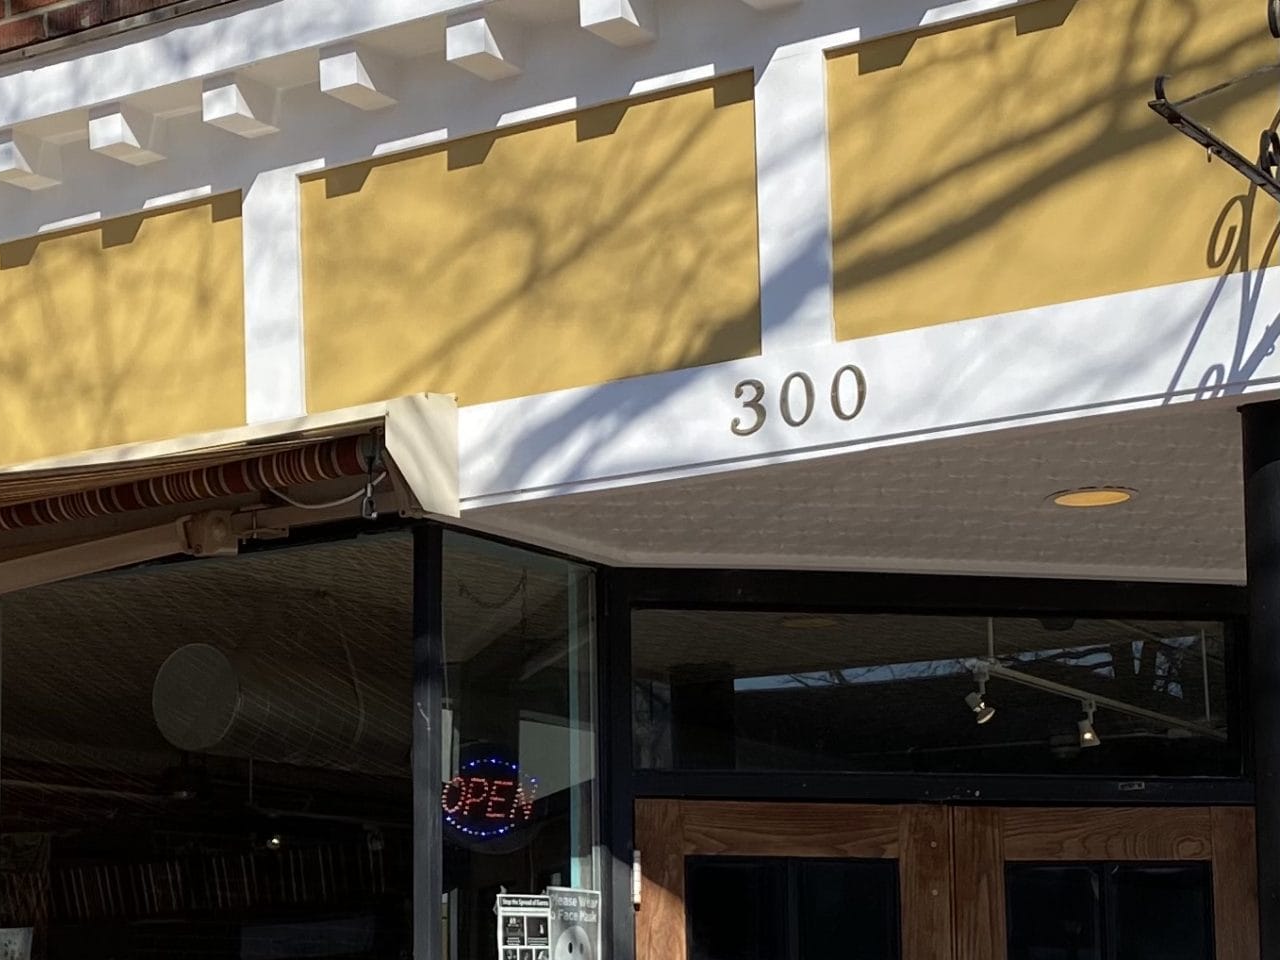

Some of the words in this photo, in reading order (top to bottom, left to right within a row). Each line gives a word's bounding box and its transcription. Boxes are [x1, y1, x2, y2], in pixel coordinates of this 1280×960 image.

[730, 364, 867, 436] 300
[441, 776, 538, 820] OPEN
[558, 909, 577, 921] Face
[579, 910, 597, 922] Mask
[578, 896, 598, 908] Wear
